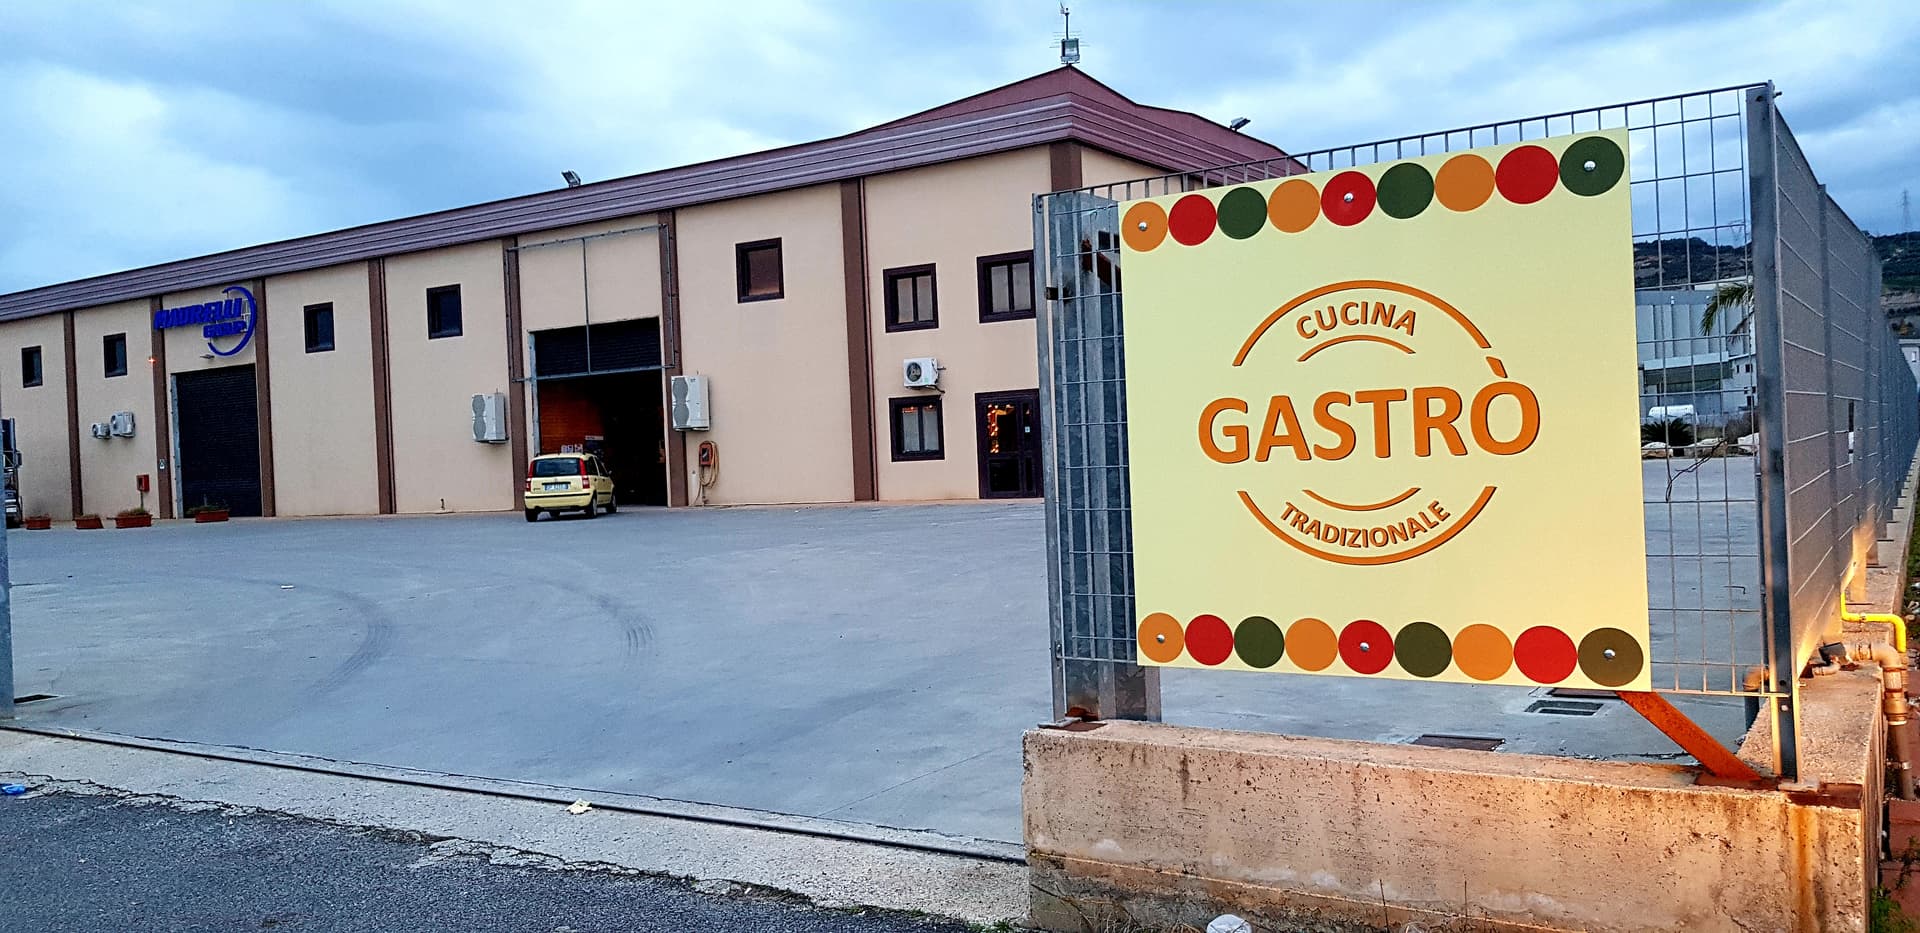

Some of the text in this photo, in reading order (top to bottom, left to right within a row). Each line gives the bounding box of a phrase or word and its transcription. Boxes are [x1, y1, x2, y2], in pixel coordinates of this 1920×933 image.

[1295, 301, 1417, 340] CUCINA
[1198, 356, 1541, 464] GASTRÒ
[1280, 499, 1451, 549] TRADIZIONALE
